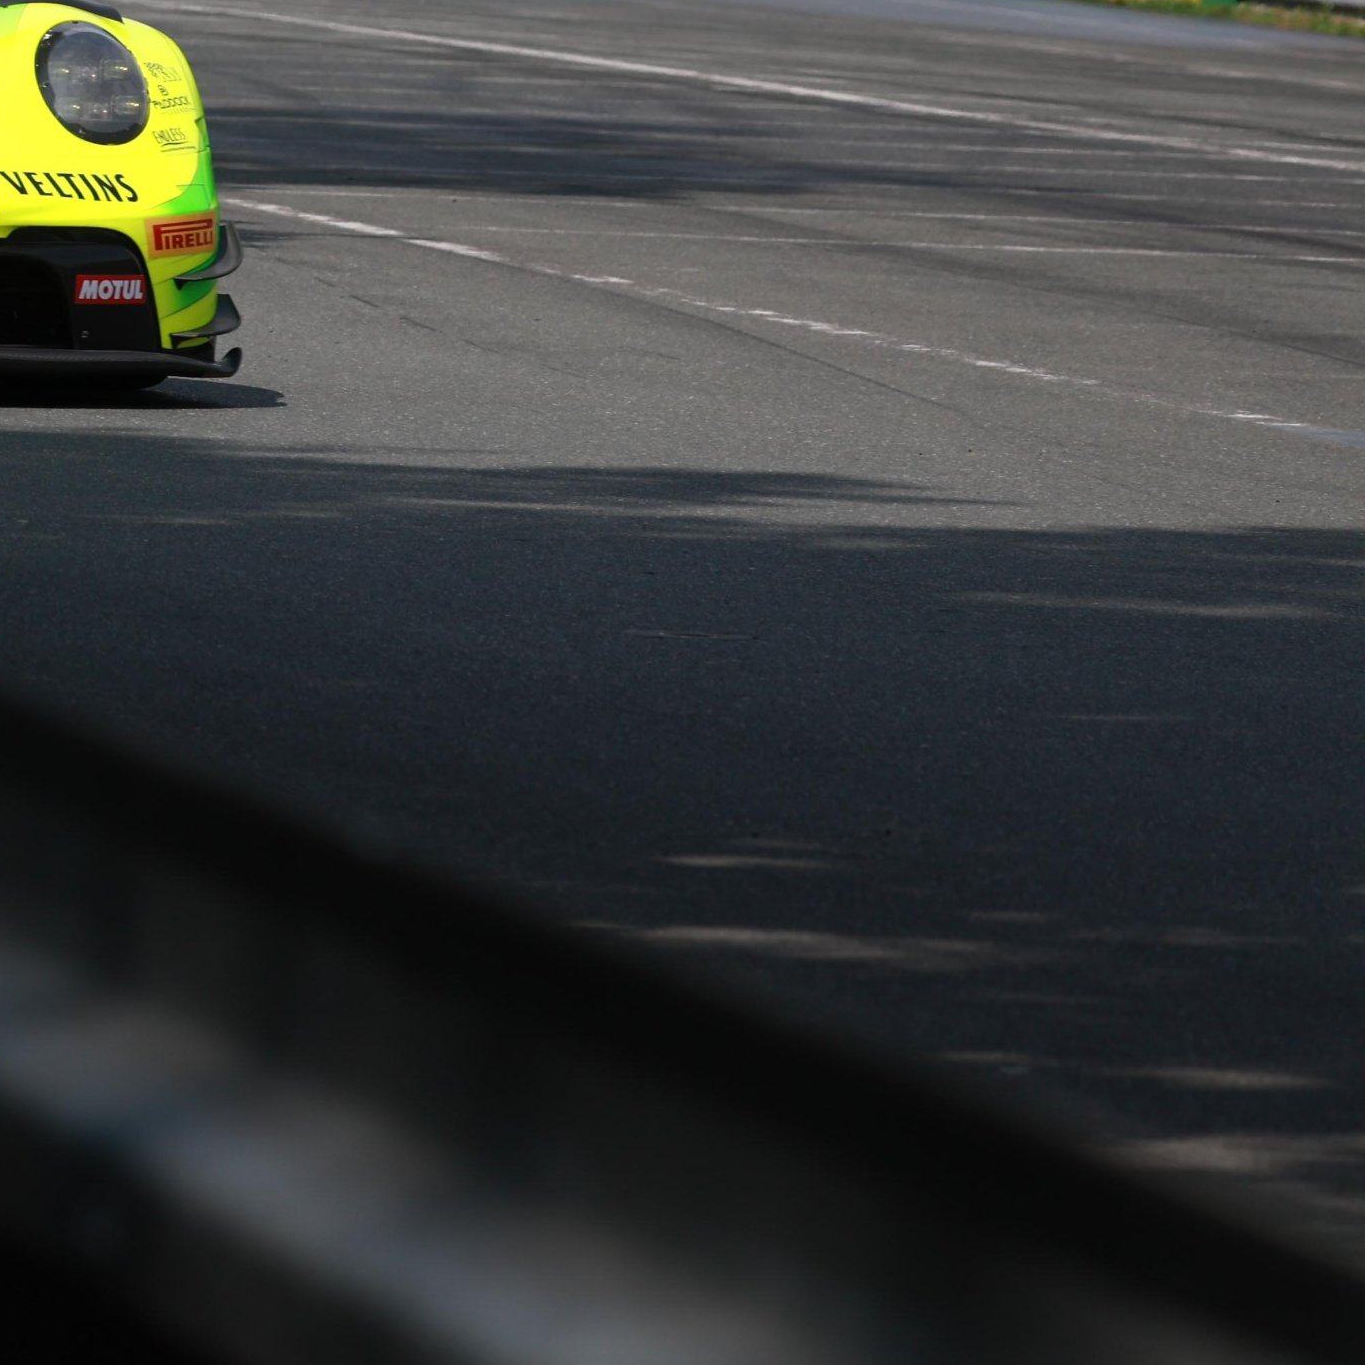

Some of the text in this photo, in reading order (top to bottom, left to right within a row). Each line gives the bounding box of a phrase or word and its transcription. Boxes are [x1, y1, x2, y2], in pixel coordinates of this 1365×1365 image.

[0, 171, 139, 203] VELTINS
[153, 218, 214, 250] PIRELLI
[77, 279, 144, 301] MOTUL
